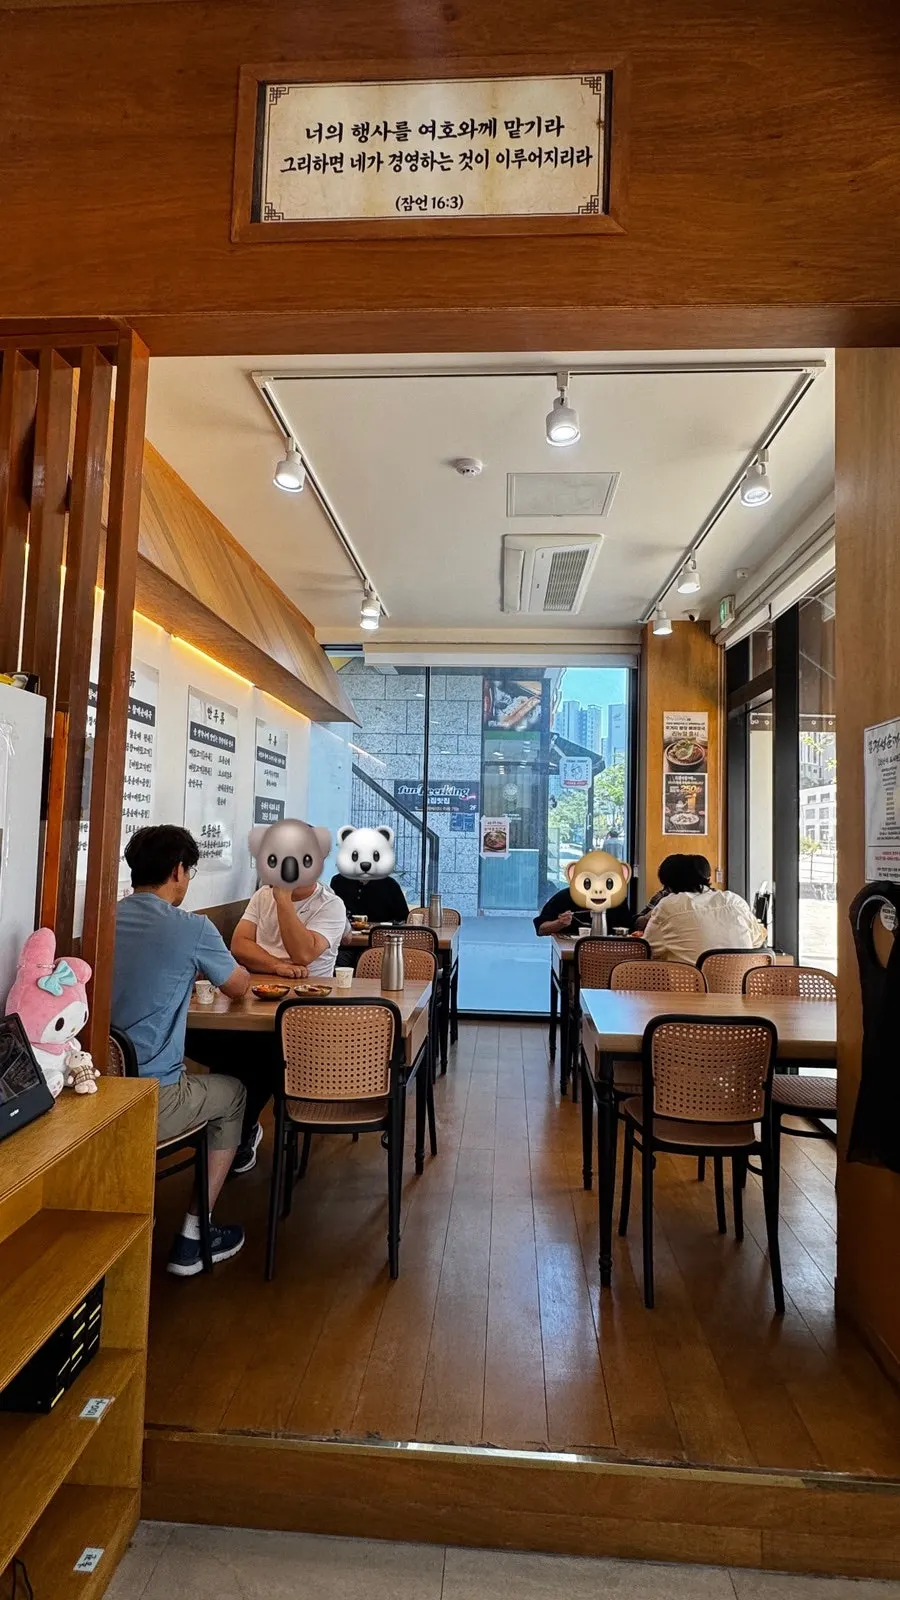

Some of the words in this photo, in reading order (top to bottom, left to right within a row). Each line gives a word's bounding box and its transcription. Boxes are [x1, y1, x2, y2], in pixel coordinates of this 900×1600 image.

[305, 121, 344, 142] 너의
[351, 120, 412, 143] 행사를
[418, 117, 498, 141] 여호와께
[504, 115, 565, 139] 맡기라
[280, 151, 345, 175] 그리하면
[350, 150, 384, 174] 네가
[388, 149, 454, 173] 경영하는
[458, 147, 490, 171] 것이
[495, 145, 594, 169] 이루어지리라
[395, 194, 429, 212] (잠언
[431, 194, 464, 211] 16:3)
[207, 706, 225, 725] 안주류
